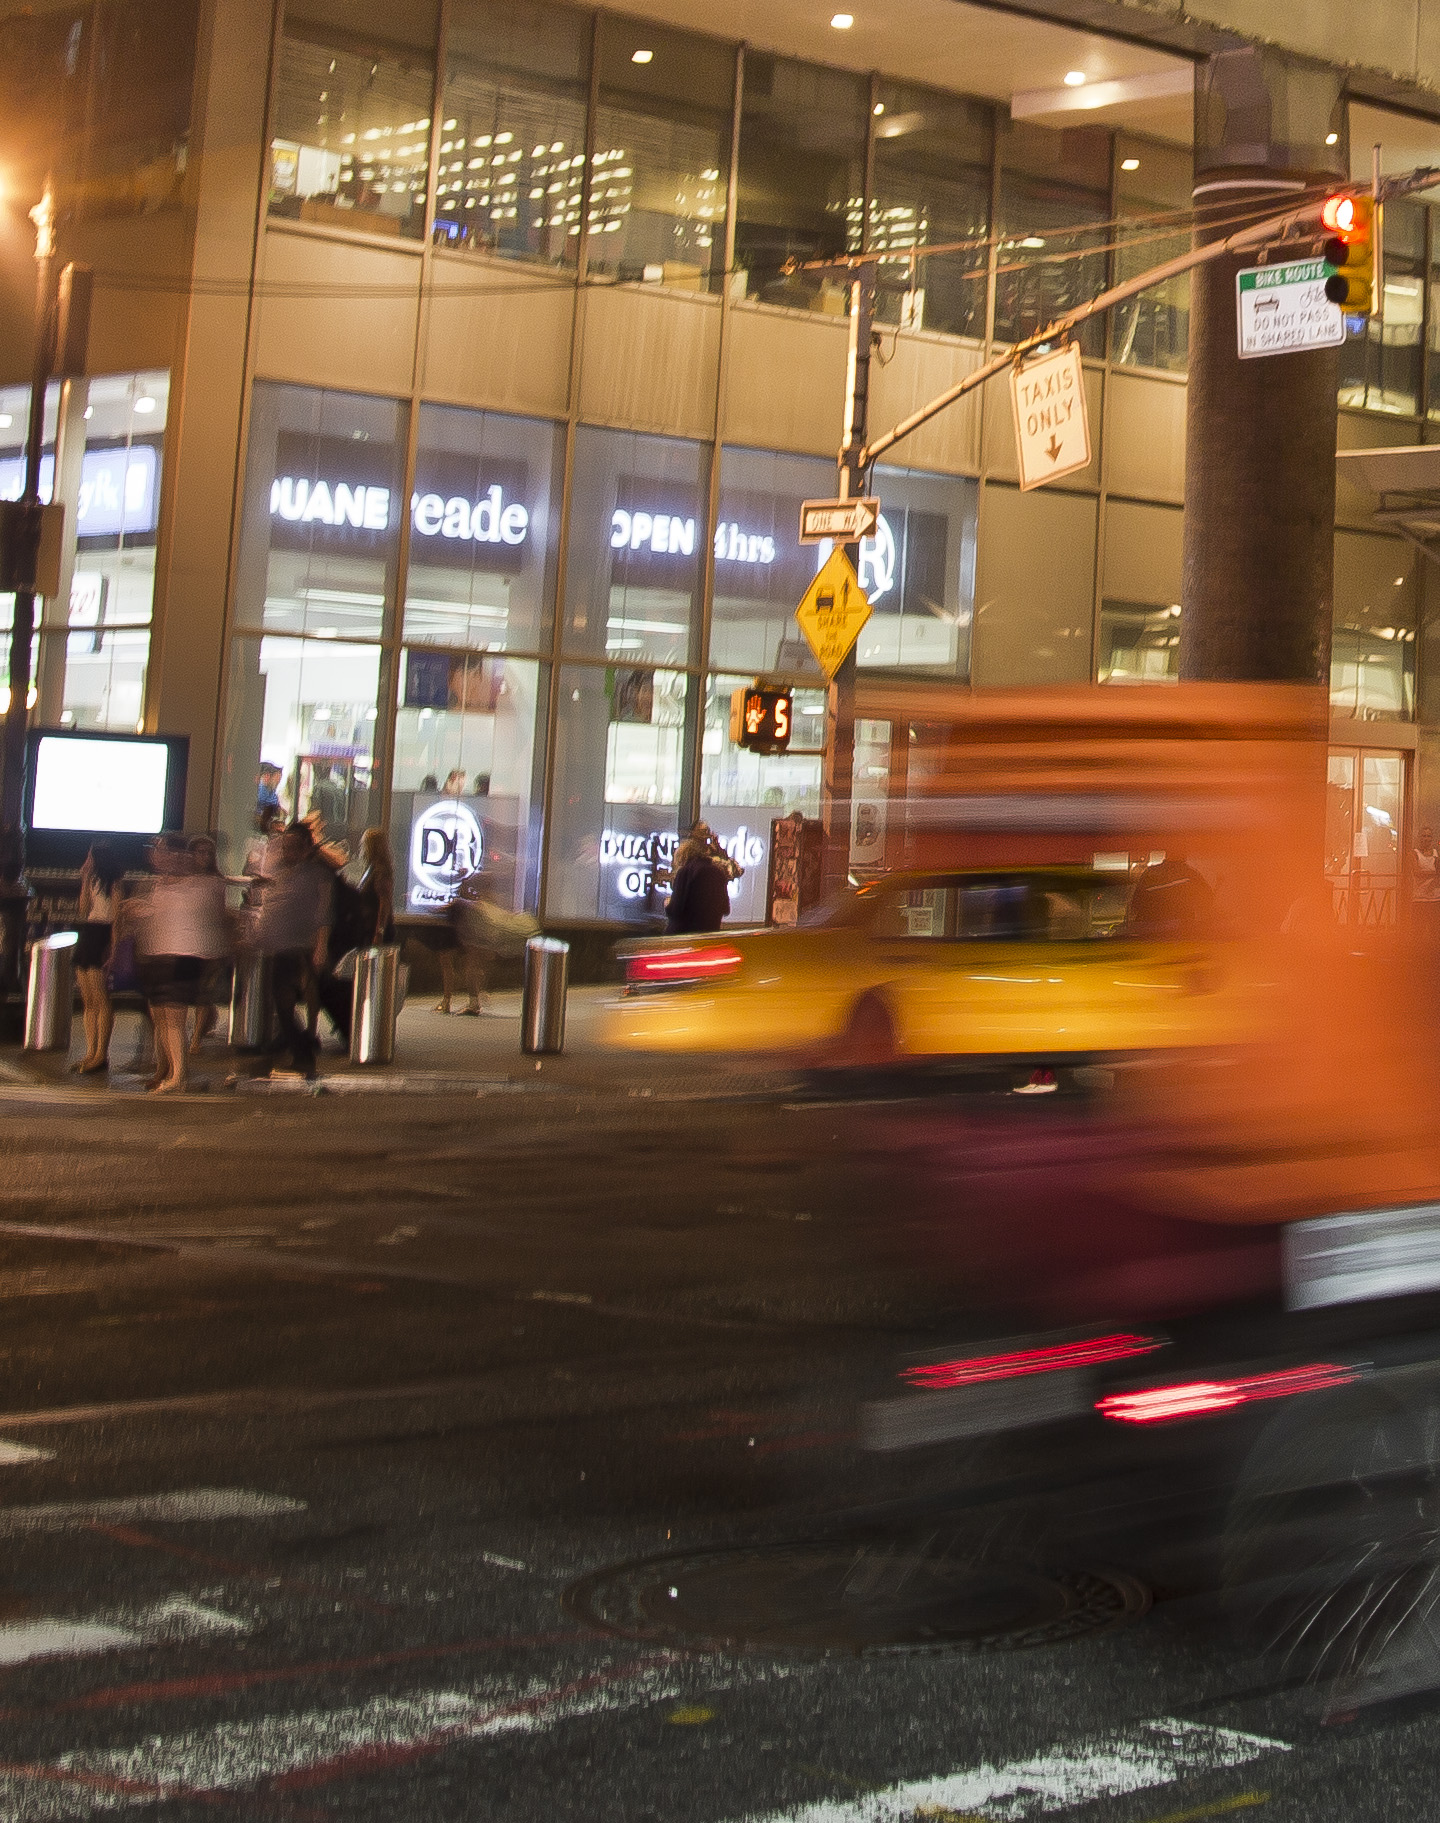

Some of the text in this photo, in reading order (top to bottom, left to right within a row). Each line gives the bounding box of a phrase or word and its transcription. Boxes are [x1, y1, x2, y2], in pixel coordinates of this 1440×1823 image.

[1255, 269, 1283, 287] BIKE
[1254, 316, 1270, 332] DO
[1273, 313, 1295, 329] NOT
[1021, 367, 1073, 408] TAXIS
[1027, 396, 1073, 436] ONLY
[774, 698, 788, 738] 5
